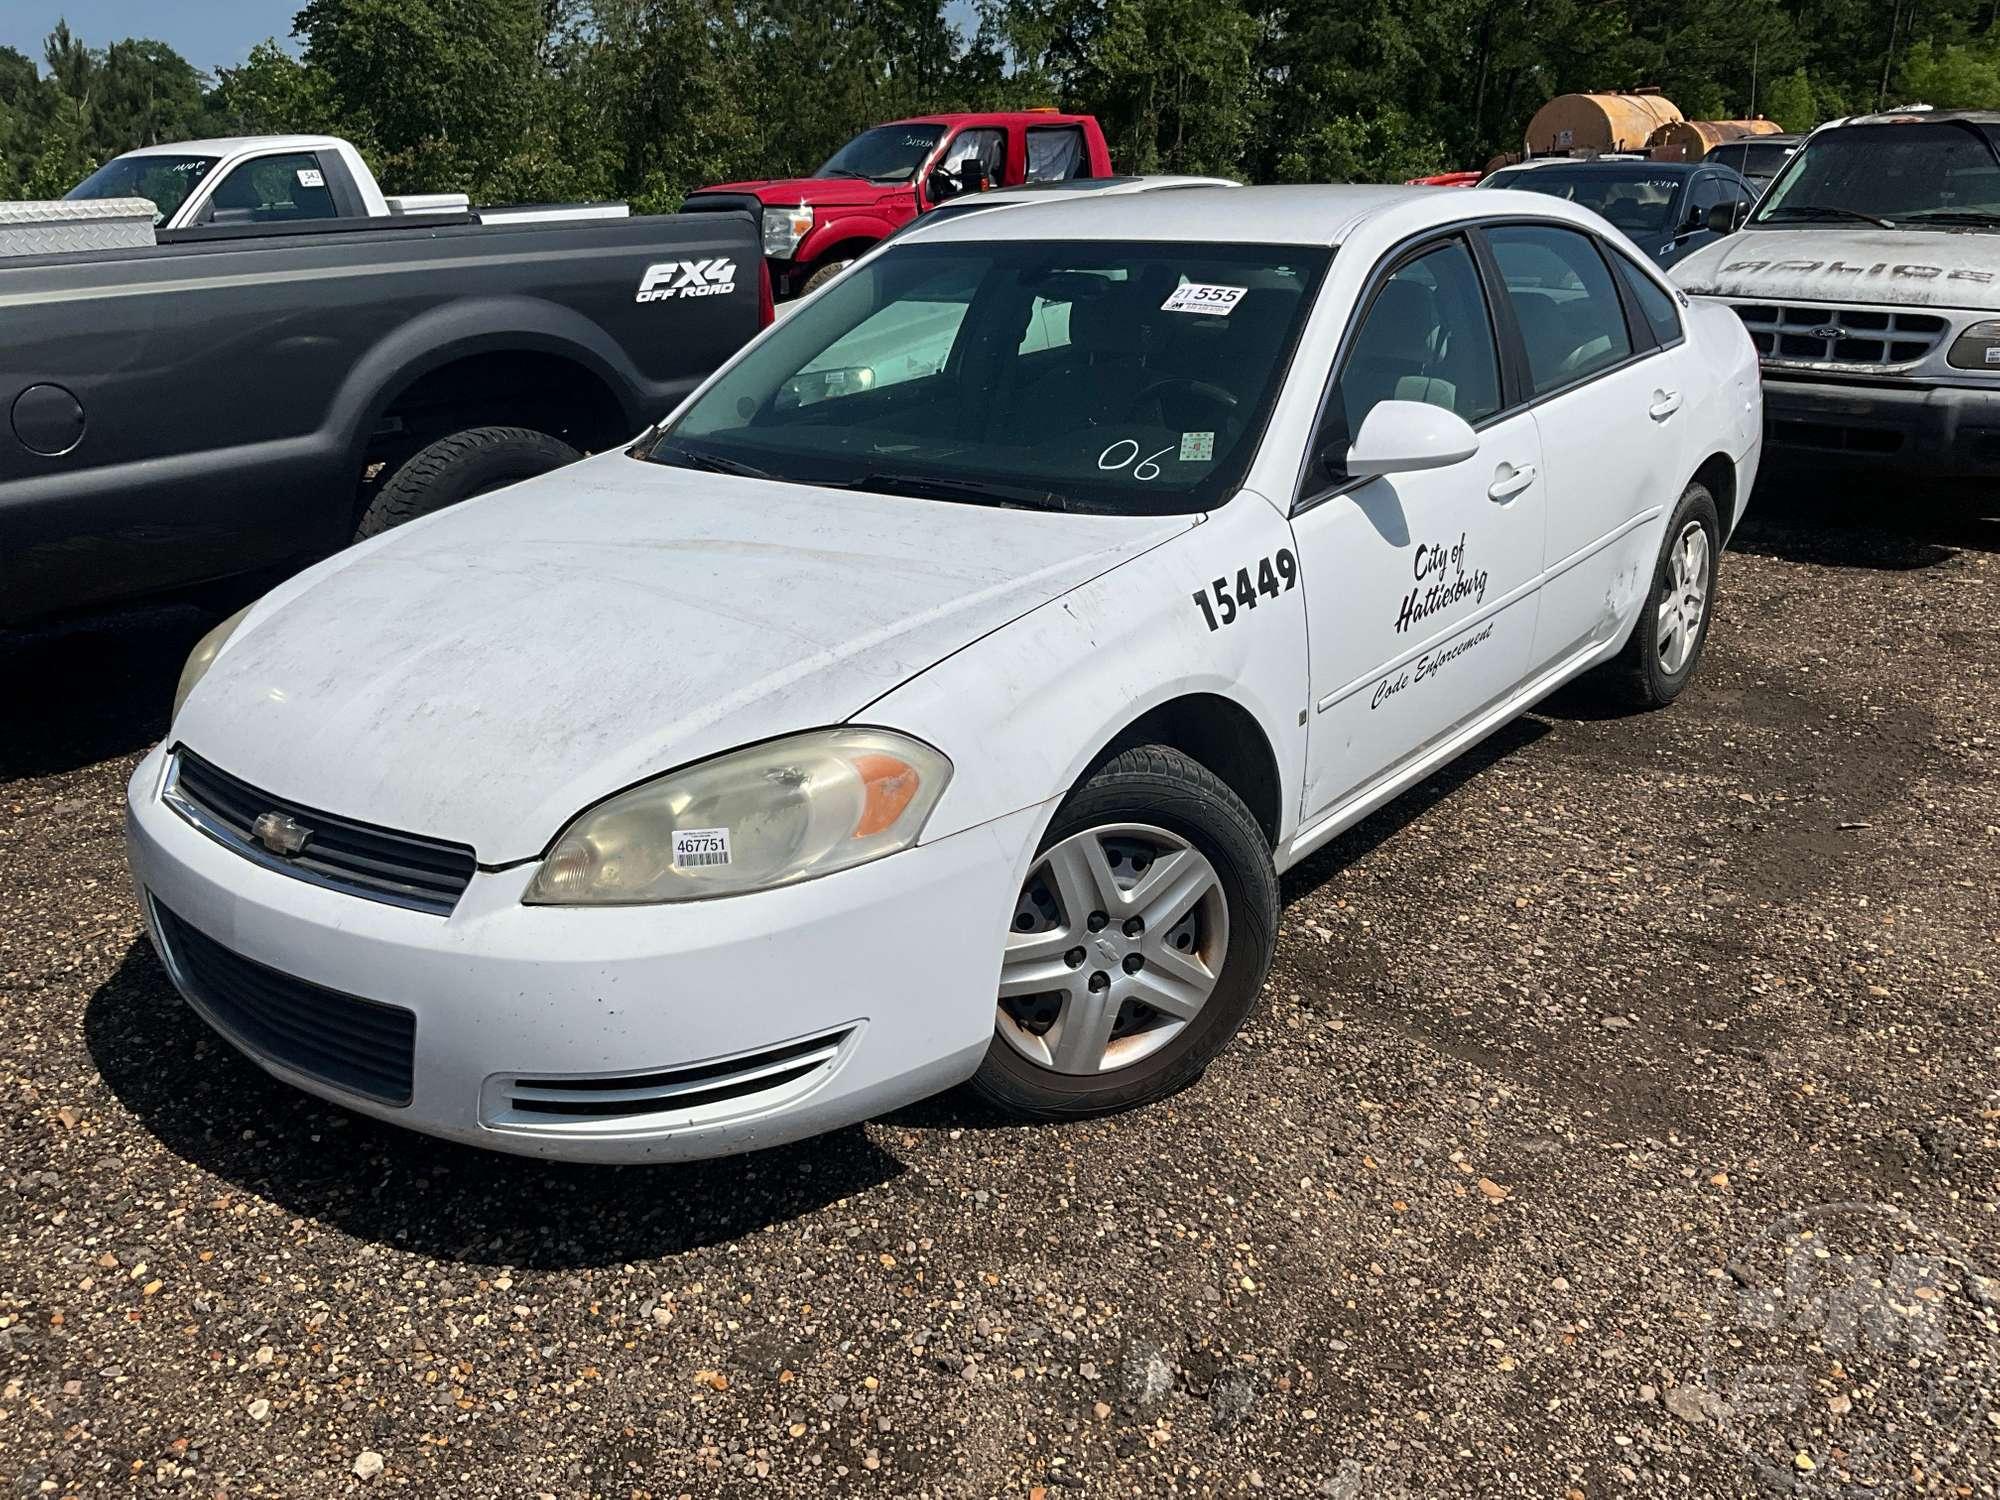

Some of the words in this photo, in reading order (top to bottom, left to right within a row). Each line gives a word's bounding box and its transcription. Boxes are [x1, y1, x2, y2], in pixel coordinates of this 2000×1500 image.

[635, 288, 677, 303] OFF
[679, 282, 736, 299] ROAD
[638, 257, 737, 292] FX4
[1173, 288, 1193, 300] 21
[1194, 287, 1240, 303] 555
[1413, 543, 1448, 582] City
[1450, 531, 1466, 575] of
[1191, 547, 1297, 633] 15449
[1393, 568, 1489, 634] Hattiesburg
[1370, 672, 1409, 710] Code
[1413, 621, 1495, 684] Enforcement
[677, 837, 725, 853] 467751
